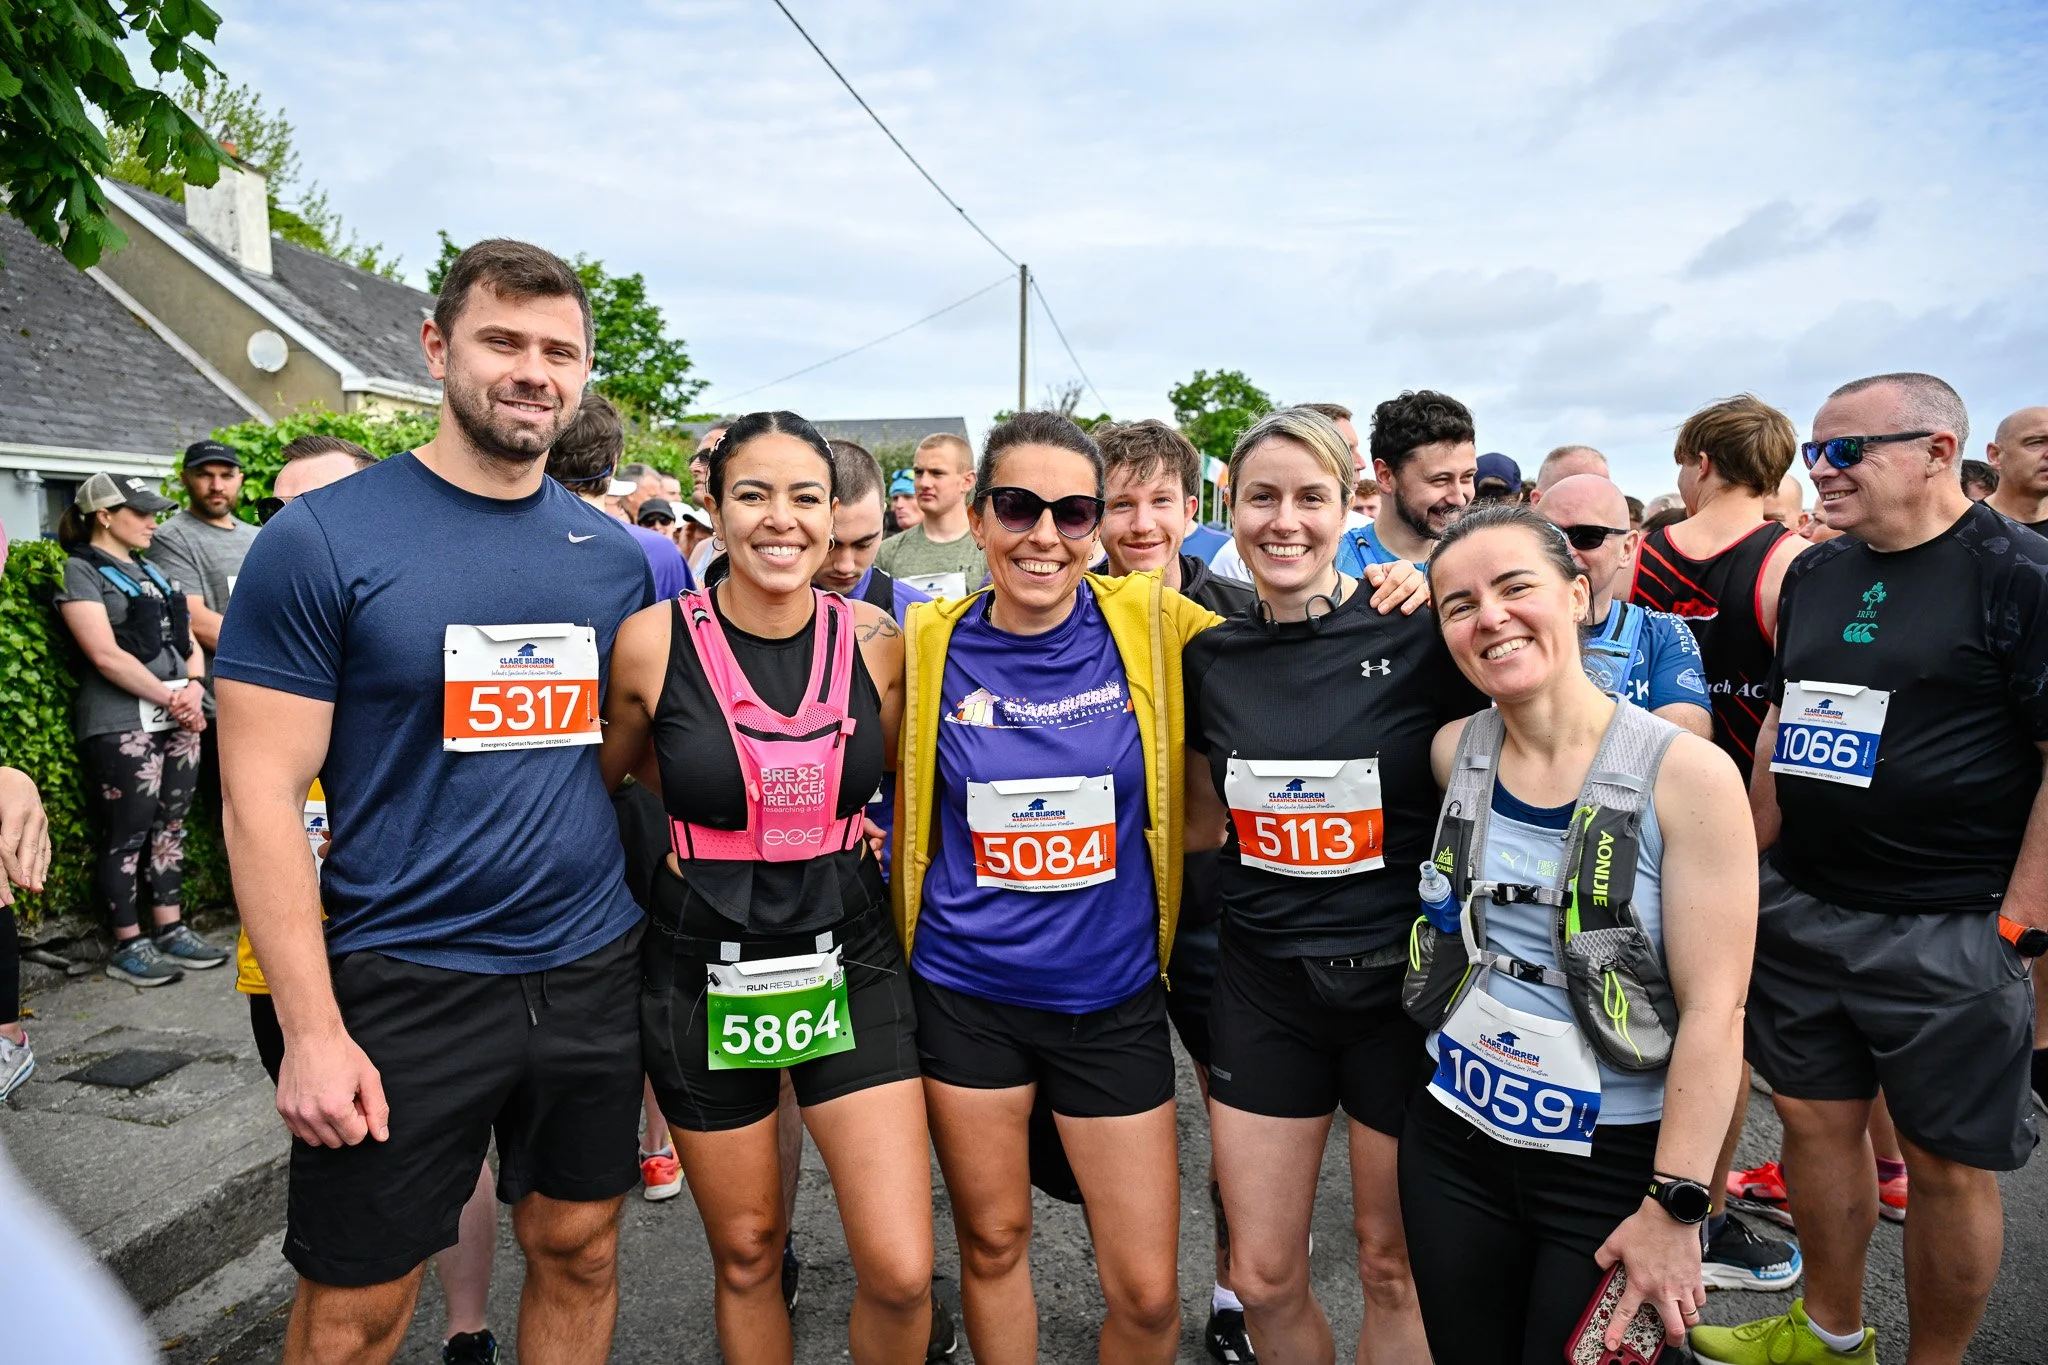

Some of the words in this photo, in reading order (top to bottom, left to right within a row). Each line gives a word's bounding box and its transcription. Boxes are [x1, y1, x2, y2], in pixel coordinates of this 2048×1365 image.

[1856, 610, 1877, 619] IRFU
[499, 657, 524, 665] CLARE
[525, 657, 555, 665] BURREN
[1004, 701, 1059, 718] CLARE
[1059, 681, 1121, 713] BURREN
[1736, 683, 1765, 699] AC
[468, 685, 581, 732] 5317
[1007, 716, 1062, 725] MARATHON
[1067, 701, 1125, 721] CHALLENGE
[1821, 709, 1844, 717] BURREN
[1782, 726, 1860, 768] 1066
[761, 779, 826, 796] CANCER
[762, 791, 826, 807] IRELAND
[763, 806, 805, 814] researching
[1011, 811, 1035, 819] CLARE
[1035, 809, 1066, 818] BURREN
[1254, 815, 1356, 861] 5113
[982, 830, 1104, 876] 5084
[1592, 829, 1615, 908] AONIJIE
[769, 976, 817, 990] RESULTS
[721, 998, 841, 1056] 5864
[1478, 1040, 1506, 1057] MARATHON
[1505, 1053, 1540, 1068] CHALLENGE
[1479, 1033, 1502, 1050] CLARE
[1502, 1045, 1540, 1062] BURREN
[1448, 1048, 1574, 1134] 1059
[1454, 1104, 1477, 1122] Emergency
[1476, 1119, 1492, 1133] Contact
[1491, 1129, 1513, 1143] Number:
[1513, 1138, 1550, 1149] 0872691147
